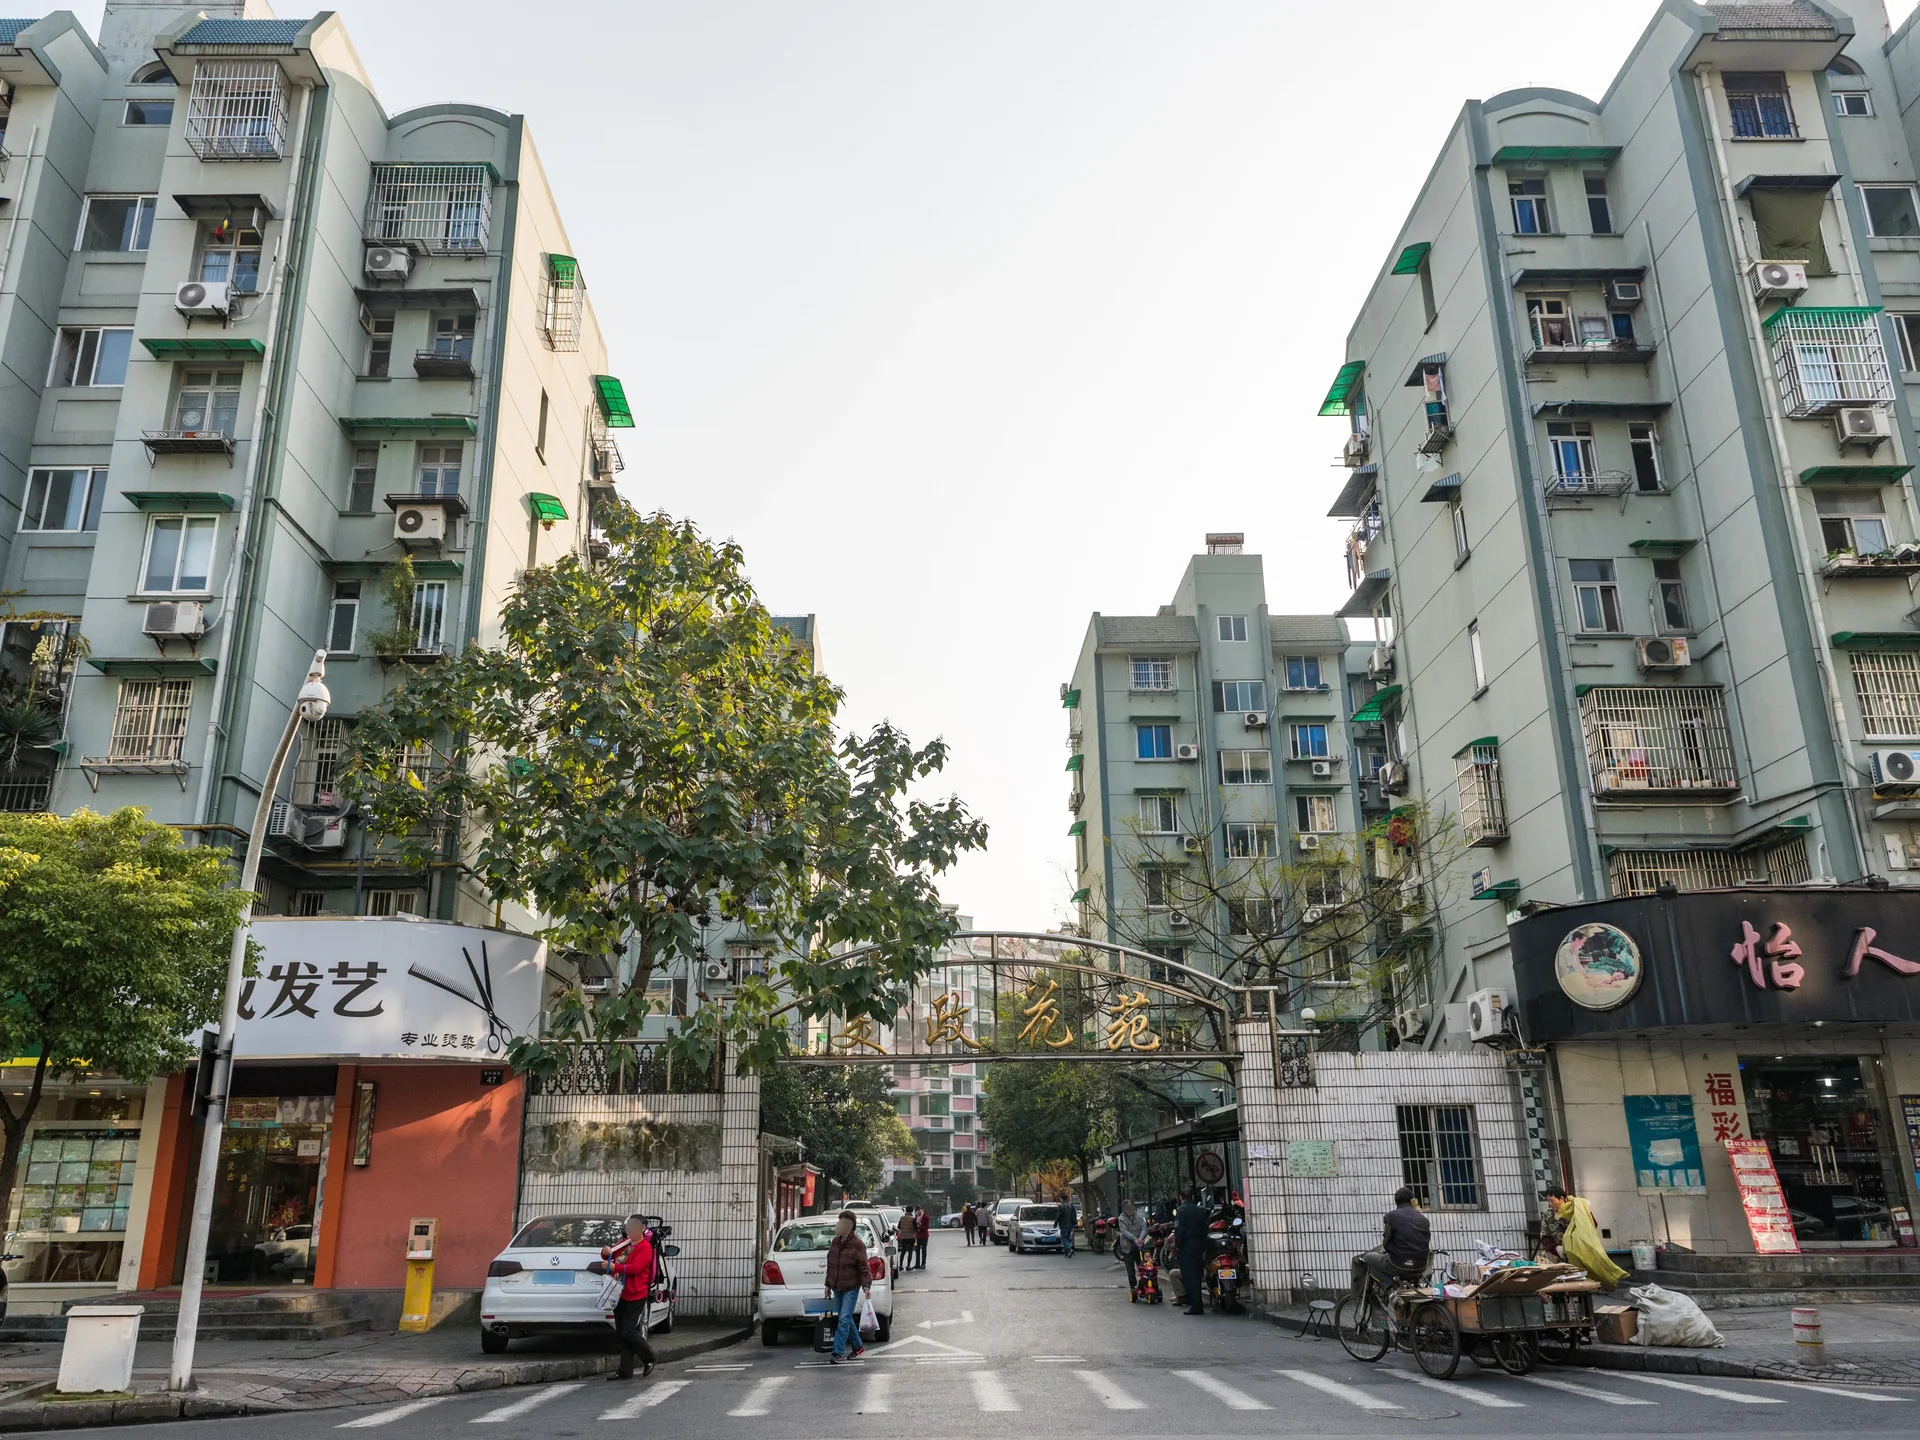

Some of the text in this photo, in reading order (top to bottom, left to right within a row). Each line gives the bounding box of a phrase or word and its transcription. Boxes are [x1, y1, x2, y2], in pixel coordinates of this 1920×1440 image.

[1730, 920, 1920, 990] 怡人
[401, 1032, 476, 1049] 专业烫染
[486, 1076, 497, 1084] 47
[1704, 1072, 1743, 1142] 福彩
